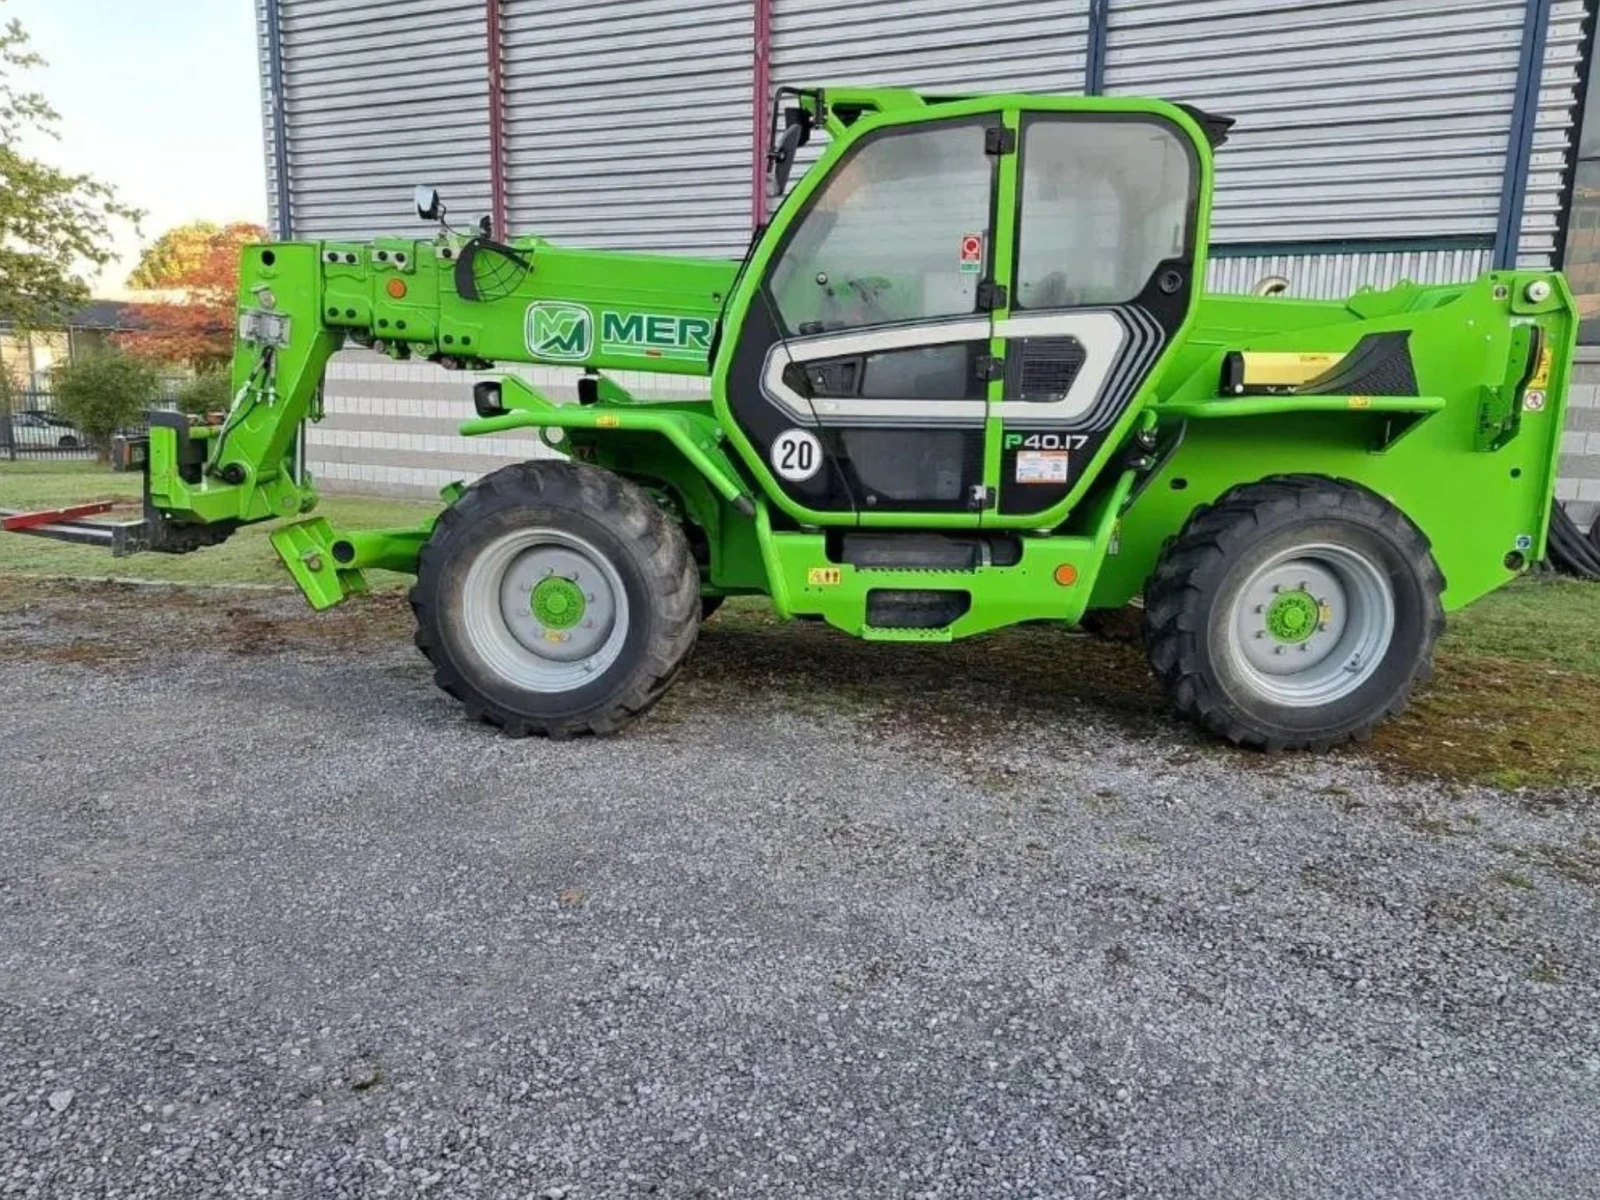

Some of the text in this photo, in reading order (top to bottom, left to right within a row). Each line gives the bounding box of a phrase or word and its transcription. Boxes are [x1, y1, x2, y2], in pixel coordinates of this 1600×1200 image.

[603, 312, 713, 347] MER
[781, 440, 812, 470] 20
[1004, 434, 1089, 450] P40.17
